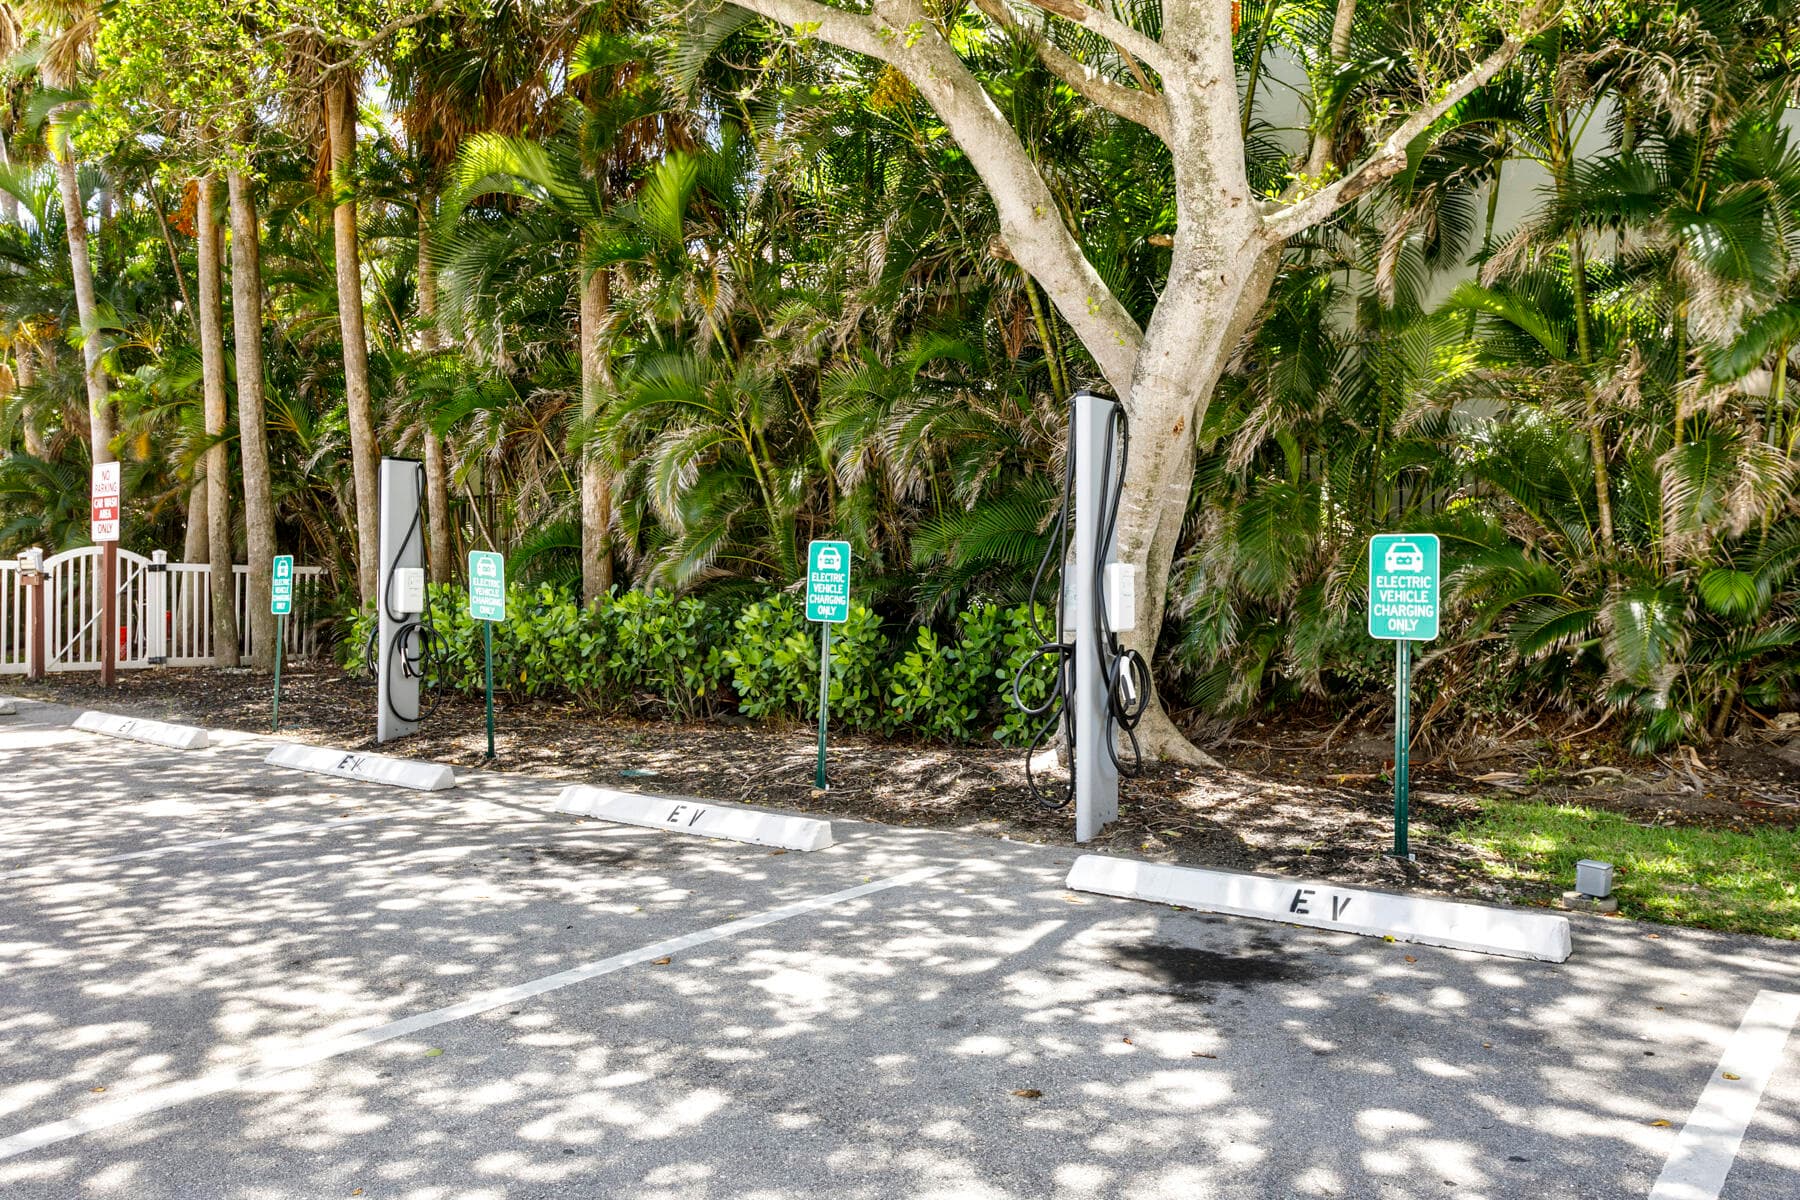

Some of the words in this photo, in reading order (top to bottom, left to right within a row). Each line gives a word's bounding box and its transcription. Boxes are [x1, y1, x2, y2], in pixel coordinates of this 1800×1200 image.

[101, 469, 110, 481] NO
[95, 481, 118, 493] PARKING
[98, 522, 113, 534] ONLY
[812, 571, 846, 583] ELECTRIC
[1376, 575, 1432, 589] ELECTRIC
[813, 583, 844, 594] VEHICLE
[809, 594, 847, 606] CHARGING
[1379, 589, 1429, 603] VEHICLE
[817, 605, 838, 616] ONLY
[1373, 604, 1434, 618] CHARGING
[1388, 618, 1419, 632] ONLY
[337, 754, 366, 771] EV
[667, 805, 706, 827] EV
[1289, 888, 1352, 921] EV
